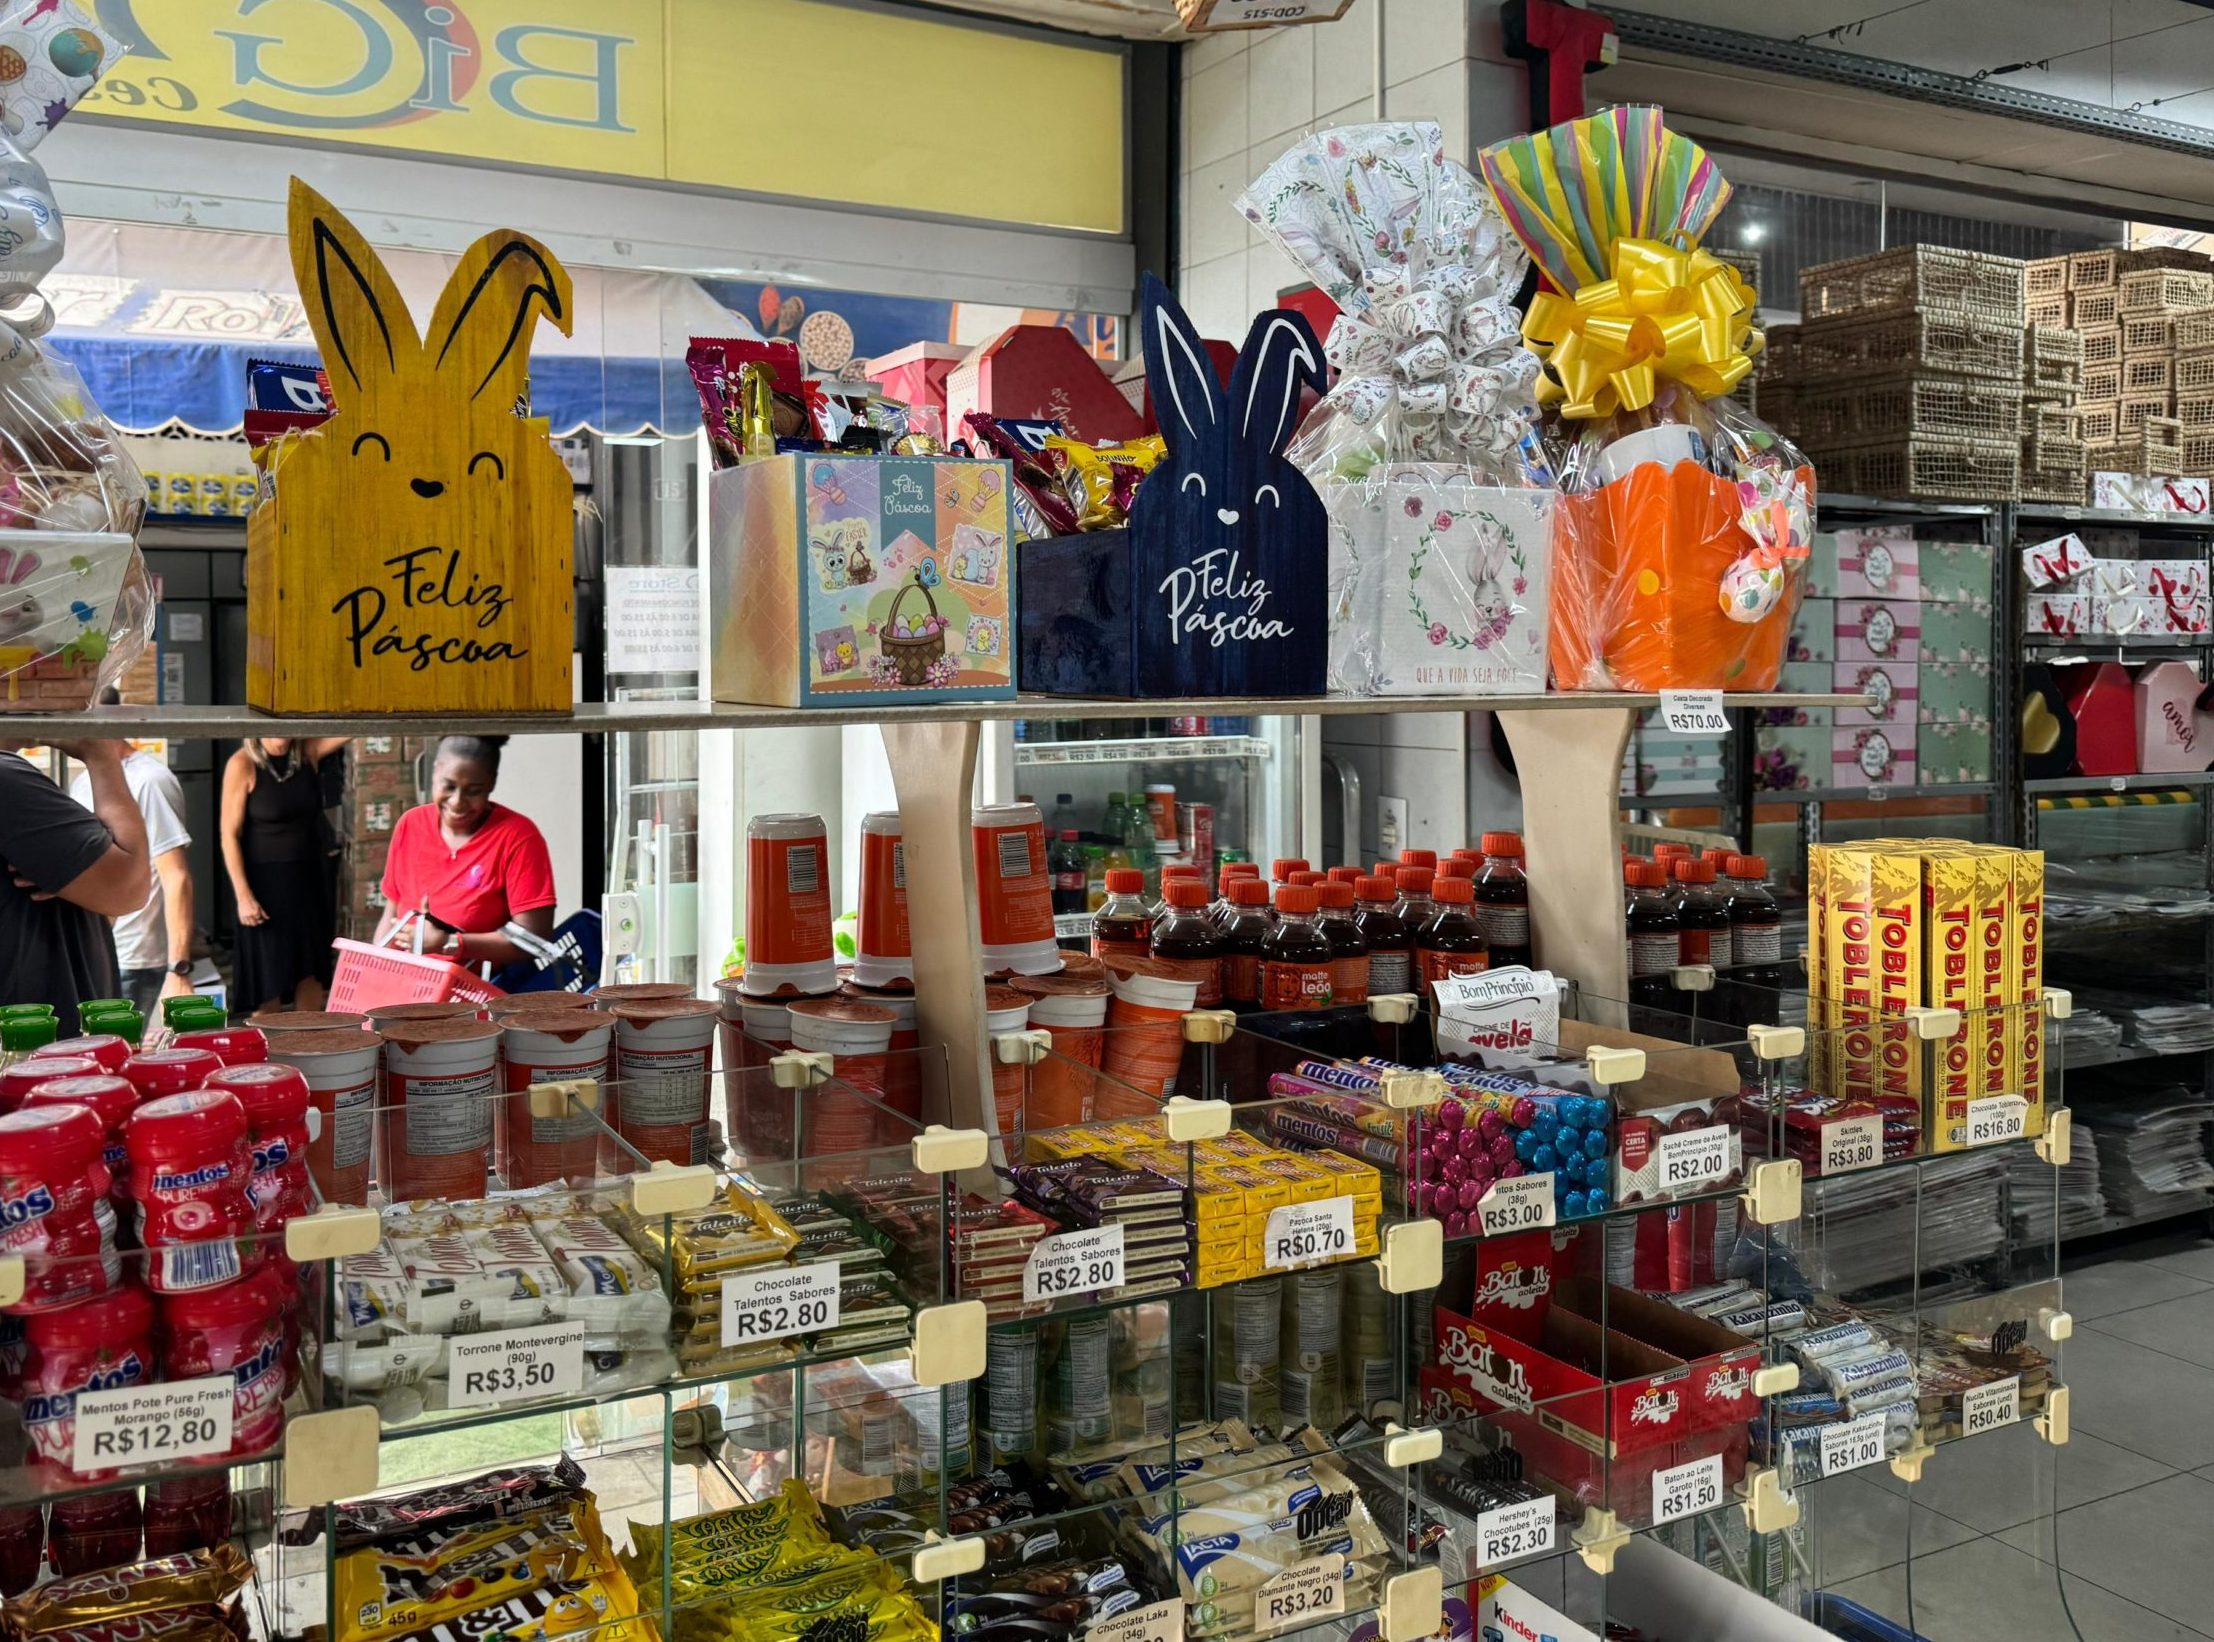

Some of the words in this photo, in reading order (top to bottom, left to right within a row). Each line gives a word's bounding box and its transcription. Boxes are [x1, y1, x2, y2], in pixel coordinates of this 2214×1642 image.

[1243, 6, 1306, 20] COD:515
[892, 474, 924, 501] Feliz
[884, 495, 932, 516] Páscoa
[383, 546, 514, 628] Feliz
[1192, 548, 1273, 614] Feliz
[1158, 566, 1295, 648] Páscoa
[331, 586, 528, 671] Páscoa
[1417, 668, 1433, 683] QUE
[1438, 668, 1444, 683] A
[1449, 668, 1468, 683] VIDA
[1473, 668, 1492, 683] SEJA
[1671, 714, 1723, 729] R$70.00
[2163, 701, 2196, 754] amor
[1302, 971, 1328, 982] matte
[1302, 977, 1332, 993] leão
[1878, 904, 1911, 1097] TOBLERON
[1981, 901, 2005, 1092] TOBLERON
[2020, 896, 2043, 1105] TOBLERONE
[1500, 1021, 1511, 1030] DE
[1275, 1113, 1340, 1146] mentos
[1625, 1137, 1646, 1146] CERTA
[1832, 1136, 1857, 1148] Original
[1683, 1138, 1702, 1148] Creme
[1668, 1154, 1722, 1182] R$2.00
[1828, 1145, 1873, 1169] R$3,80
[153, 1161, 231, 1189] mentos
[1092, 1174, 1140, 1184] Talento
[1515, 1180, 1548, 1193] Sabores
[161, 1187, 199, 1204] PURE
[1289, 1216, 1312, 1228] Paçoca
[1314, 1212, 1334, 1223] Santa
[1485, 1203, 1543, 1230] R$3.00
[1291, 1225, 1315, 1237] Helena
[1315, 1222, 1333, 1234] (20g)
[1051, 1236, 1102, 1254] Chocolate
[1277, 1227, 1346, 1260] R$0.70
[1034, 1252, 1076, 1269] Talentos
[1080, 1246, 1121, 1263] Sabores
[753, 1273, 813, 1293] Chocolate
[1036, 1260, 1115, 1295] R$2.80
[734, 1292, 783, 1311] Talentos
[788, 1285, 836, 1302] Sabores
[737, 1300, 828, 1338] R$2.80
[1728, 1302, 1802, 1327] Kakauzinho
[456, 1342, 502, 1357] Torrone
[505, 1332, 583, 1351] Montevergine
[507, 1351, 537, 1365] (90g)
[465, 1362, 555, 1395] R$3,50
[1985, 1382, 2017, 1396] Vitaminada
[82, 1400, 129, 1416] Mentos
[133, 1396, 163, 1409] Pote
[165, 1392, 194, 1406] Pure
[197, 1388, 233, 1402] Fresh
[1972, 1400, 1997, 1411] Sabores
[114, 1411, 171, 1426] Morango
[173, 1405, 205, 1420] (56g)
[1969, 1404, 2011, 1431] R$0.40
[93, 1419, 216, 1456] R$12,80
[1823, 1430, 1851, 1442] Chocolate
[1825, 1440, 1848, 1451] Sabores
[1829, 1441, 1877, 1470] R$1.00
[1664, 1474, 1685, 1487] Baton
[1686, 1471, 1696, 1482] ao
[1697, 1464, 1714, 1477] Leite
[1661, 1485, 1716, 1518] R$1.50
[1669, 1482, 1692, 1496] Garoto
[1484, 1521, 1531, 1539] Chocotubes
[1534, 1514, 1554, 1528] (25g)
[1498, 1506, 1537, 1524] Hershey's
[1183, 1534, 1233, 1562] LACTA
[1487, 1527, 1548, 1561] R$2.30
[1258, 1583, 1296, 1599] Diamante
[1297, 1575, 1321, 1589] Negro
[1322, 1569, 1342, 1585] (34g)
[1281, 1565, 1321, 1581] Chocolate
[1479, 1574, 1498, 1592] NOVO
[1270, 1585, 1334, 1618] R$3,20
[388, 1612, 417, 1627] 45g
[1096, 1616, 1144, 1636] Chocolate
[1145, 1608, 1169, 1622] Laka
[1494, 1601, 1540, 1642] kinder
